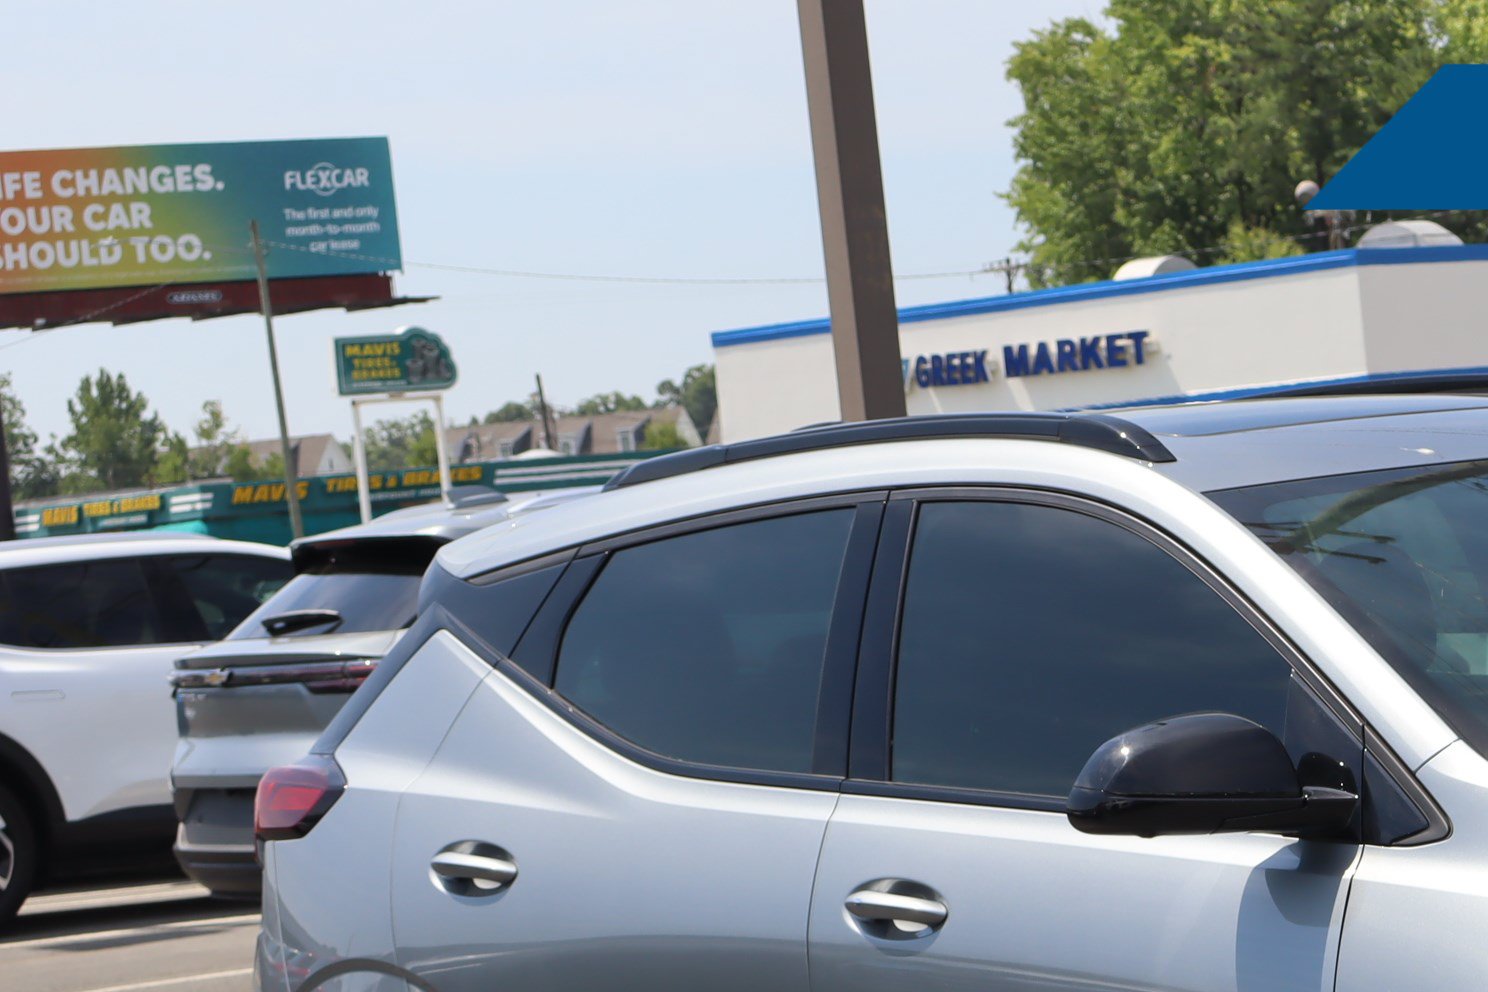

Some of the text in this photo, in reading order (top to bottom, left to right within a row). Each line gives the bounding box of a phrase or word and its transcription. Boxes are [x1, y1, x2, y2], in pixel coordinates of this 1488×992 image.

[51, 163, 225, 198] CHANGES.
[284, 167, 369, 190] FLEXCAR
[0, 202, 153, 234] OUR CAR
[284, 205, 379, 220] The first and only
[285, 222, 380, 237] month-to-month
[130, 234, 212, 264] TOO.
[345, 342, 400, 356] MAVIS
[915, 331, 1150, 388] GREEK MARKET
[232, 481, 309, 505] MAVS
[326, 474, 382, 493] TIRS
